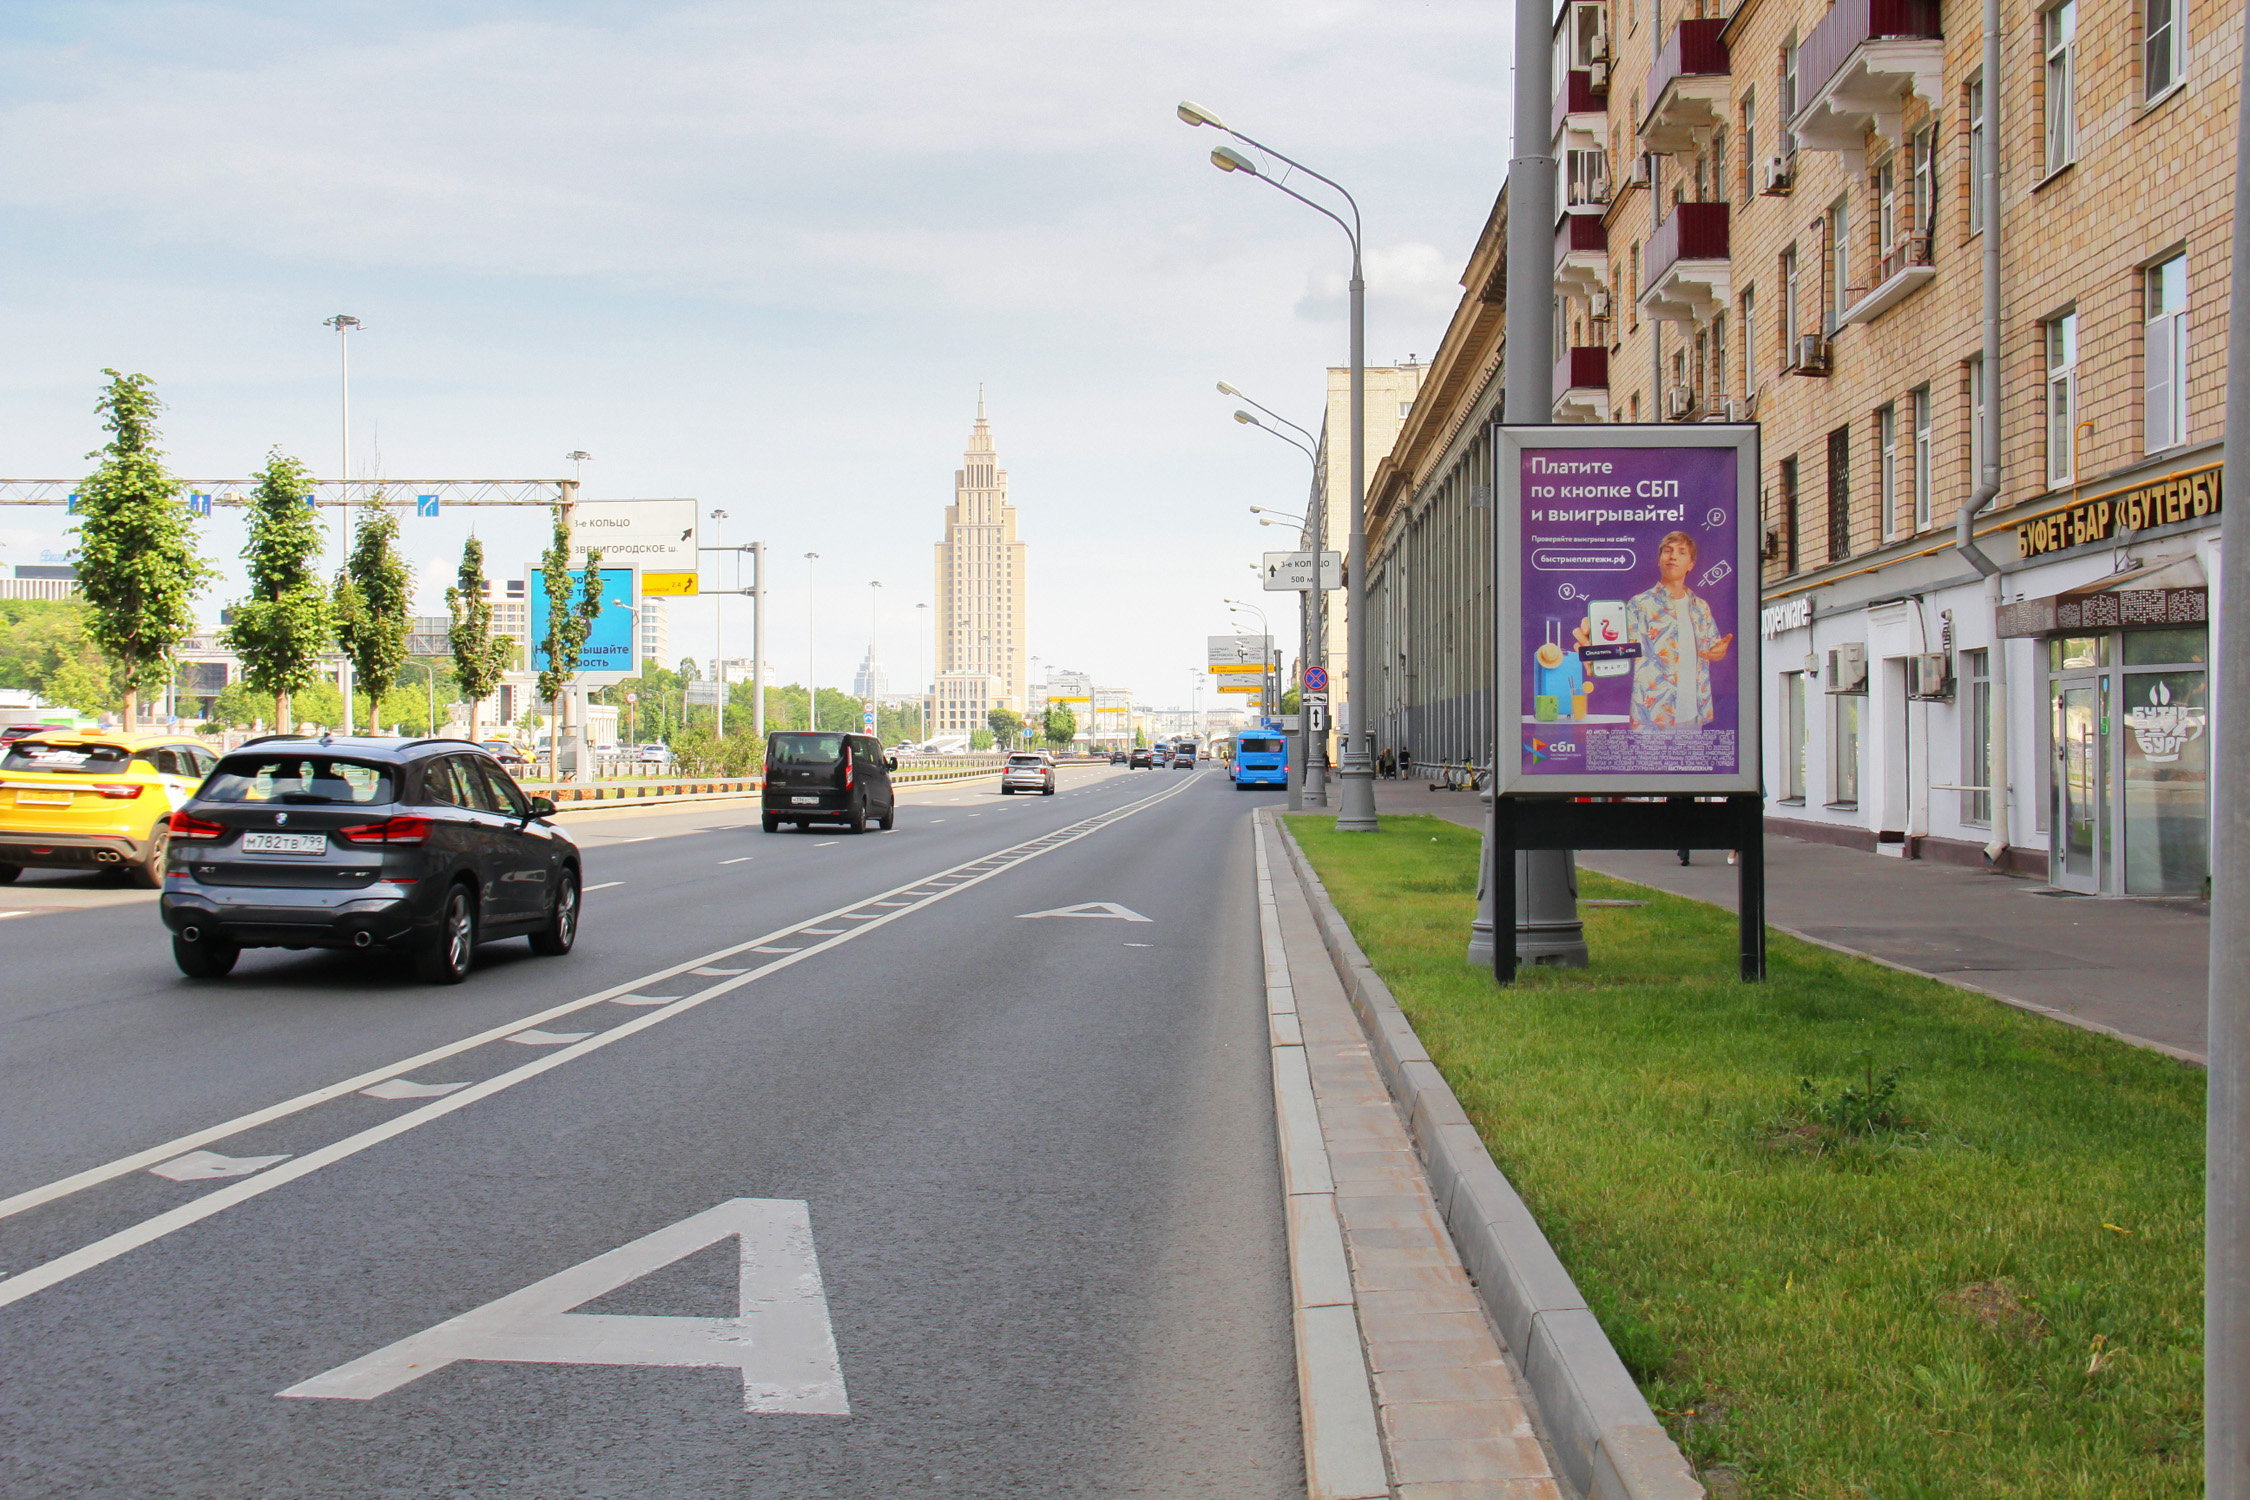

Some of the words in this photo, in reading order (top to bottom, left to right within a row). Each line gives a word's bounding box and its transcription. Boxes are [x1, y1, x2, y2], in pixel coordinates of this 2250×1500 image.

[1531, 457, 1613, 475] Платите
[1531, 485, 1555, 498] по
[1560, 485, 1632, 498] кнопке
[1636, 480, 1679, 498] СБП
[1531, 509, 1543, 521] и
[1548, 503, 1684, 526] выигрывайте!
[2017, 500, 2110, 559] БУФЕТ-БАР
[2115, 469, 2223, 531] «БУТЕРБУ
[589, 518, 631, 529] КОЛЬЦО
[1531, 535, 1573, 544] Проверяйте
[1573, 536, 1606, 544] выигрыш
[1615, 535, 1636, 543] сайте
[1294, 560, 1330, 569] КОЛЦО
[1540, 554, 1626, 565] быстрыеплатежи.рф
[1291, 575, 1305, 583] 500
[1549, 741, 1576, 753] сбп
